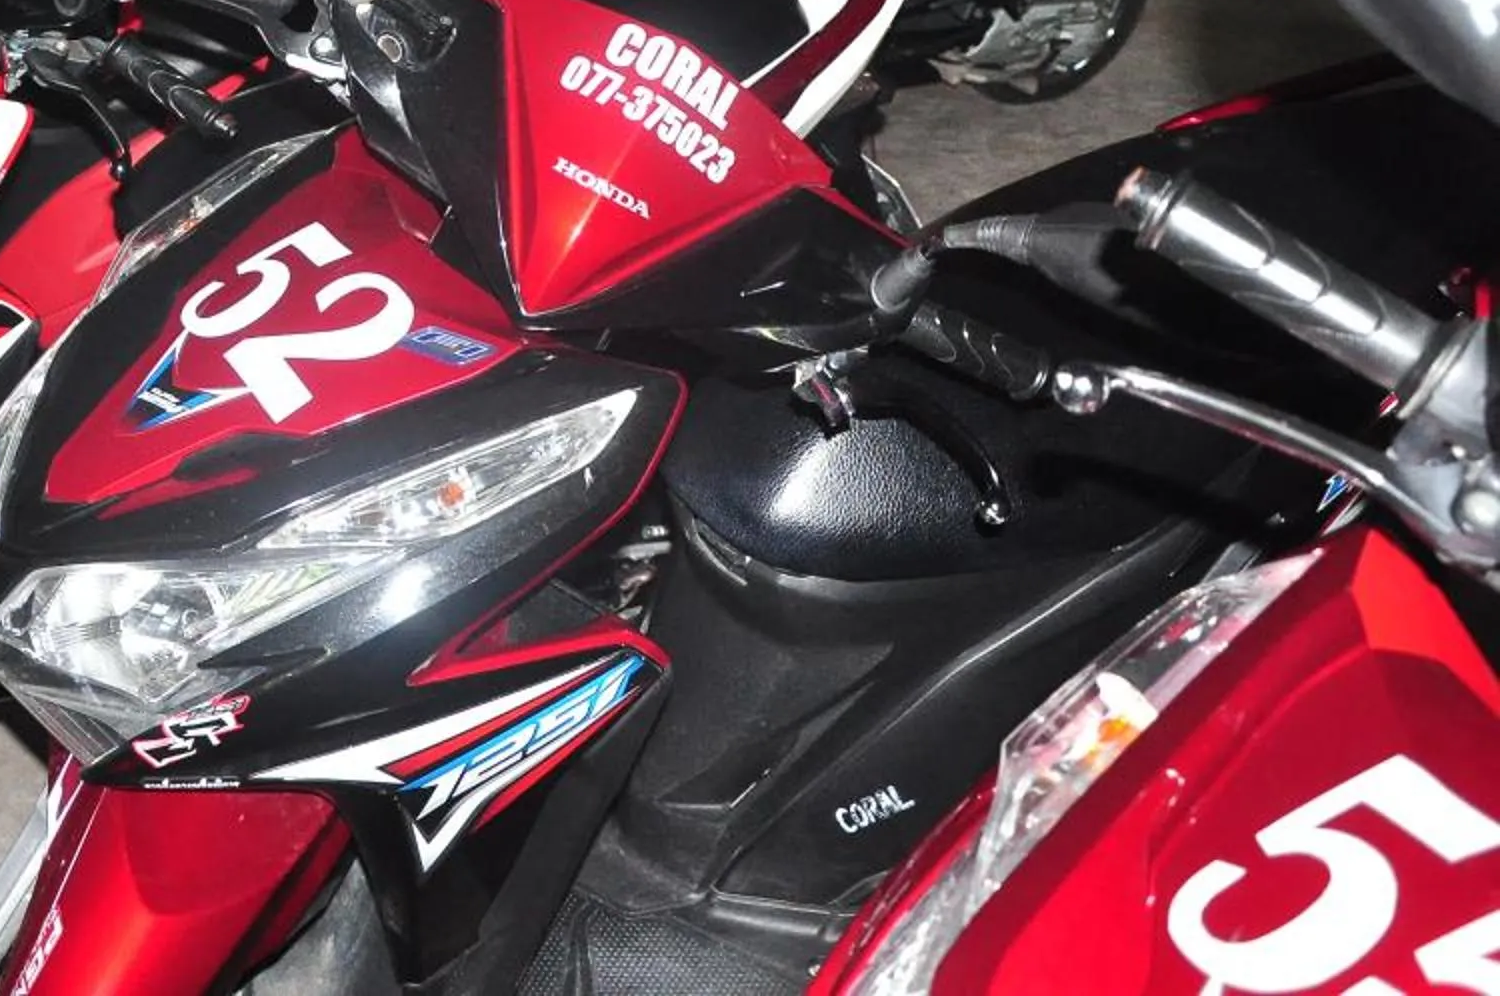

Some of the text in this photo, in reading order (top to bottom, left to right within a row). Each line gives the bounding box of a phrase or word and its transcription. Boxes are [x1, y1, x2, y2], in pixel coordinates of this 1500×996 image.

[559, 55, 736, 185] 077-375023
[604, 22, 740, 132] CORAL
[551, 156, 651, 221] HONDA
[180, 221, 415, 424] 52
[835, 785, 916, 833] CORAL
